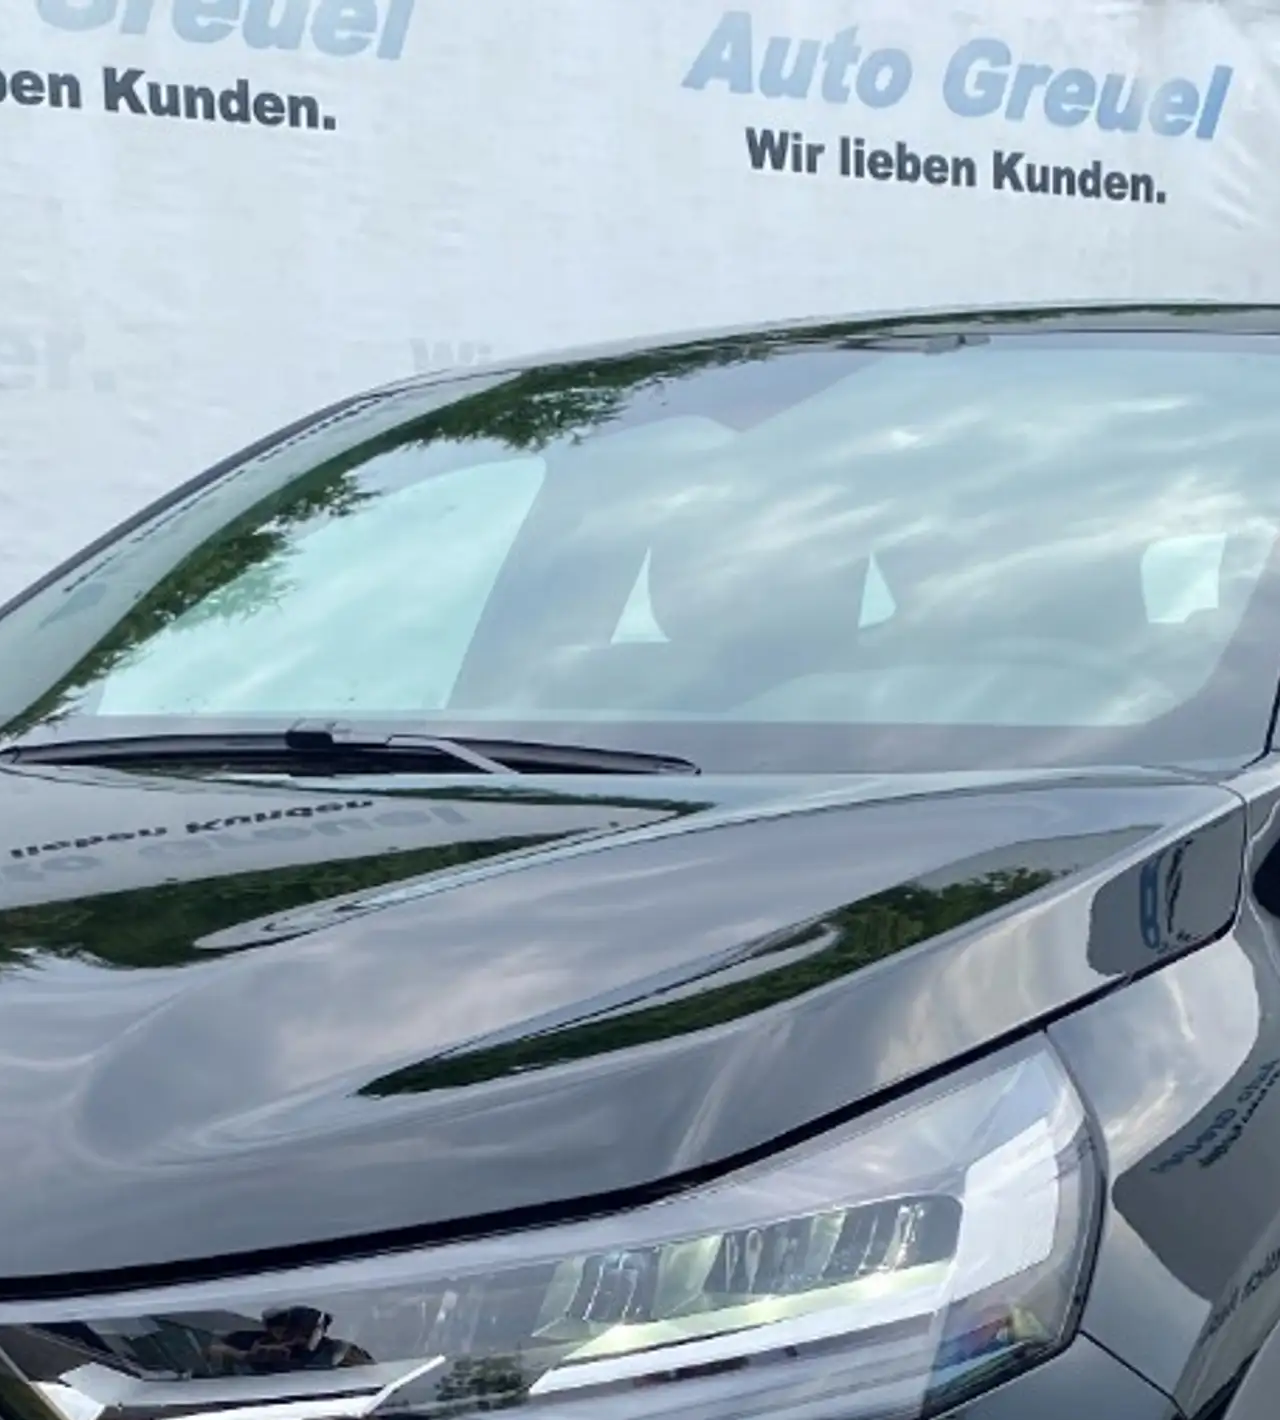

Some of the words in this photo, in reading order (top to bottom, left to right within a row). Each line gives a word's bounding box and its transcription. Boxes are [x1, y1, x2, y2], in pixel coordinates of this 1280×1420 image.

[103, 67, 337, 130] Kunden.
[682, 12, 911, 110] Auto
[943, 37, 1232, 141] Greuel
[745, 127, 825, 174] Wir
[840, 137, 977, 188] lieben
[992, 151, 1167, 205] Kunden.
